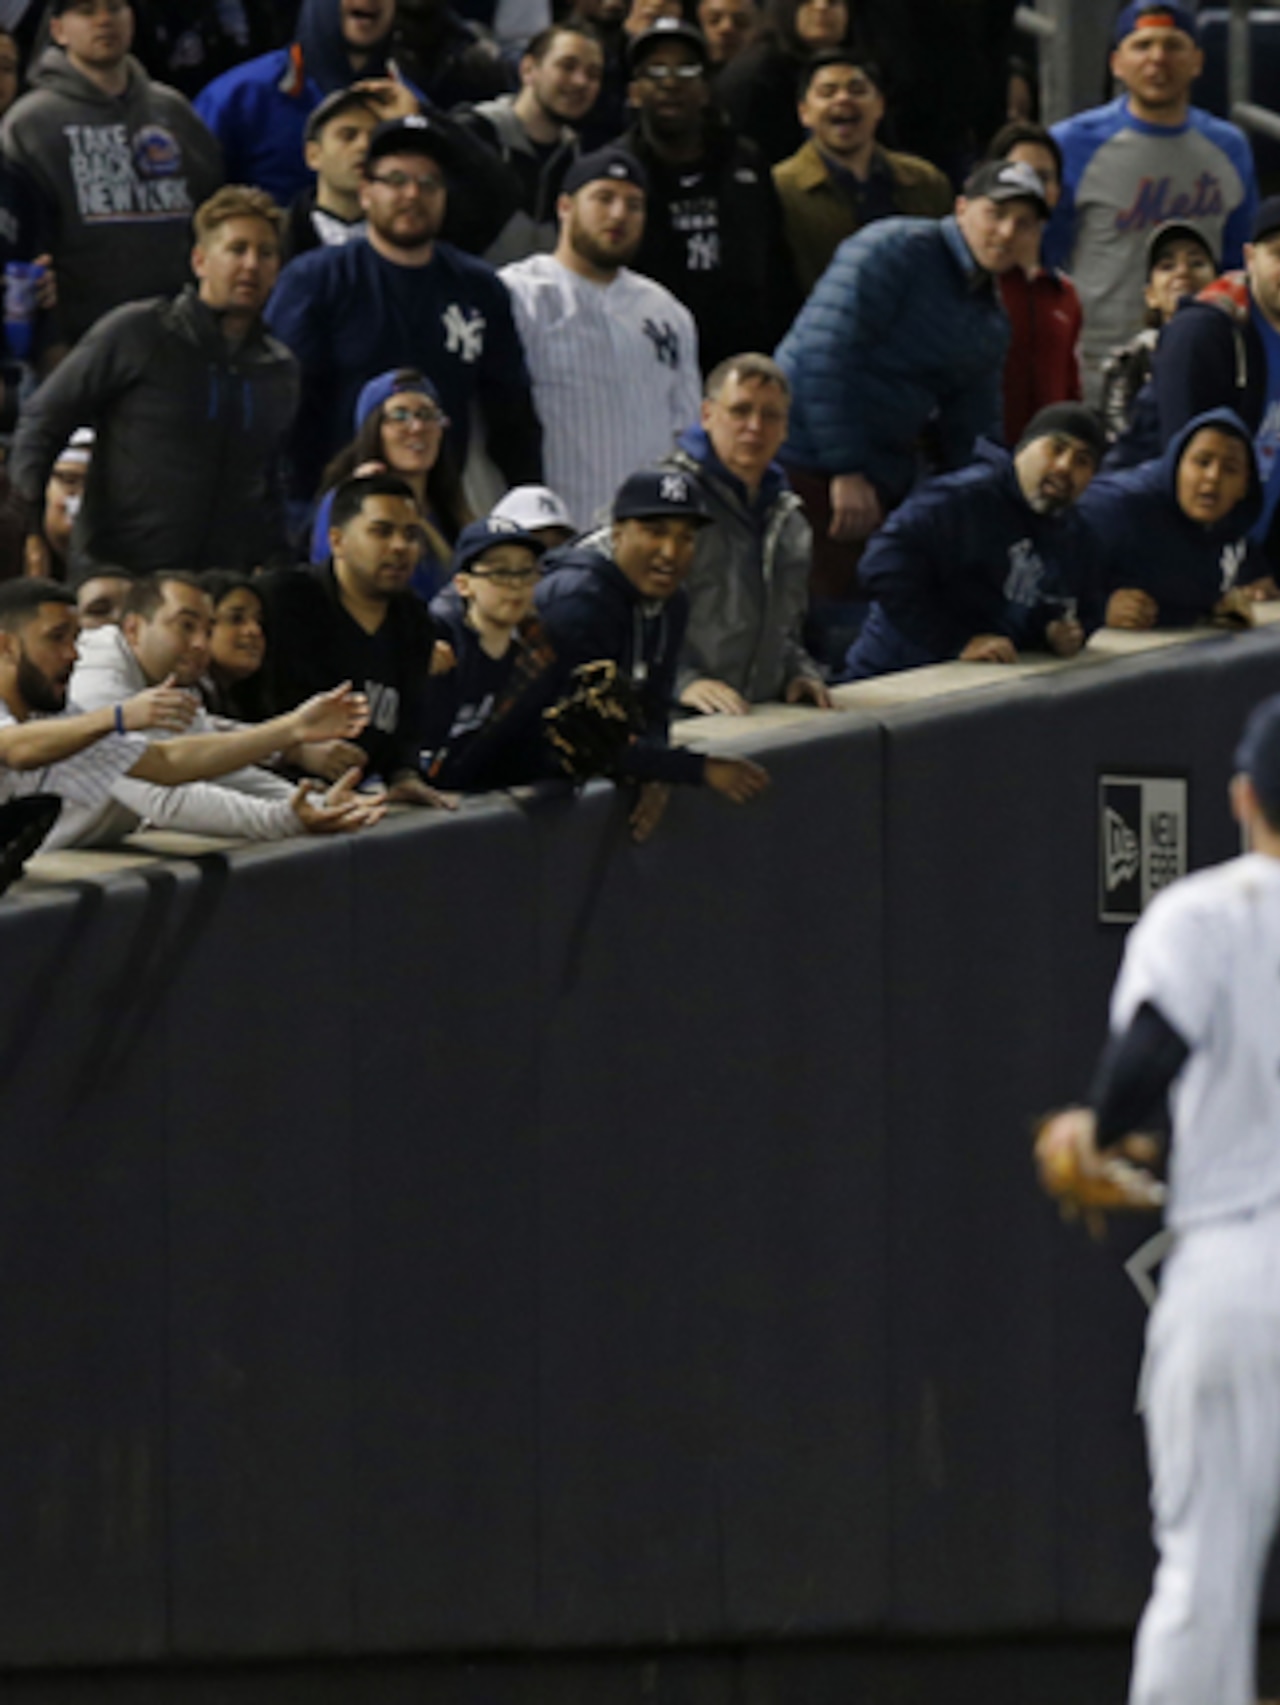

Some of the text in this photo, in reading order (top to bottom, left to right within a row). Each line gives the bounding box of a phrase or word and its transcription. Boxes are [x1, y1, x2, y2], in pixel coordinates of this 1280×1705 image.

[63, 124, 128, 157] TAKE
[70, 147, 138, 184] BACK
[76, 181, 132, 214] NEW
[1115, 171, 1222, 231] Mets
[442, 303, 487, 362] NY
